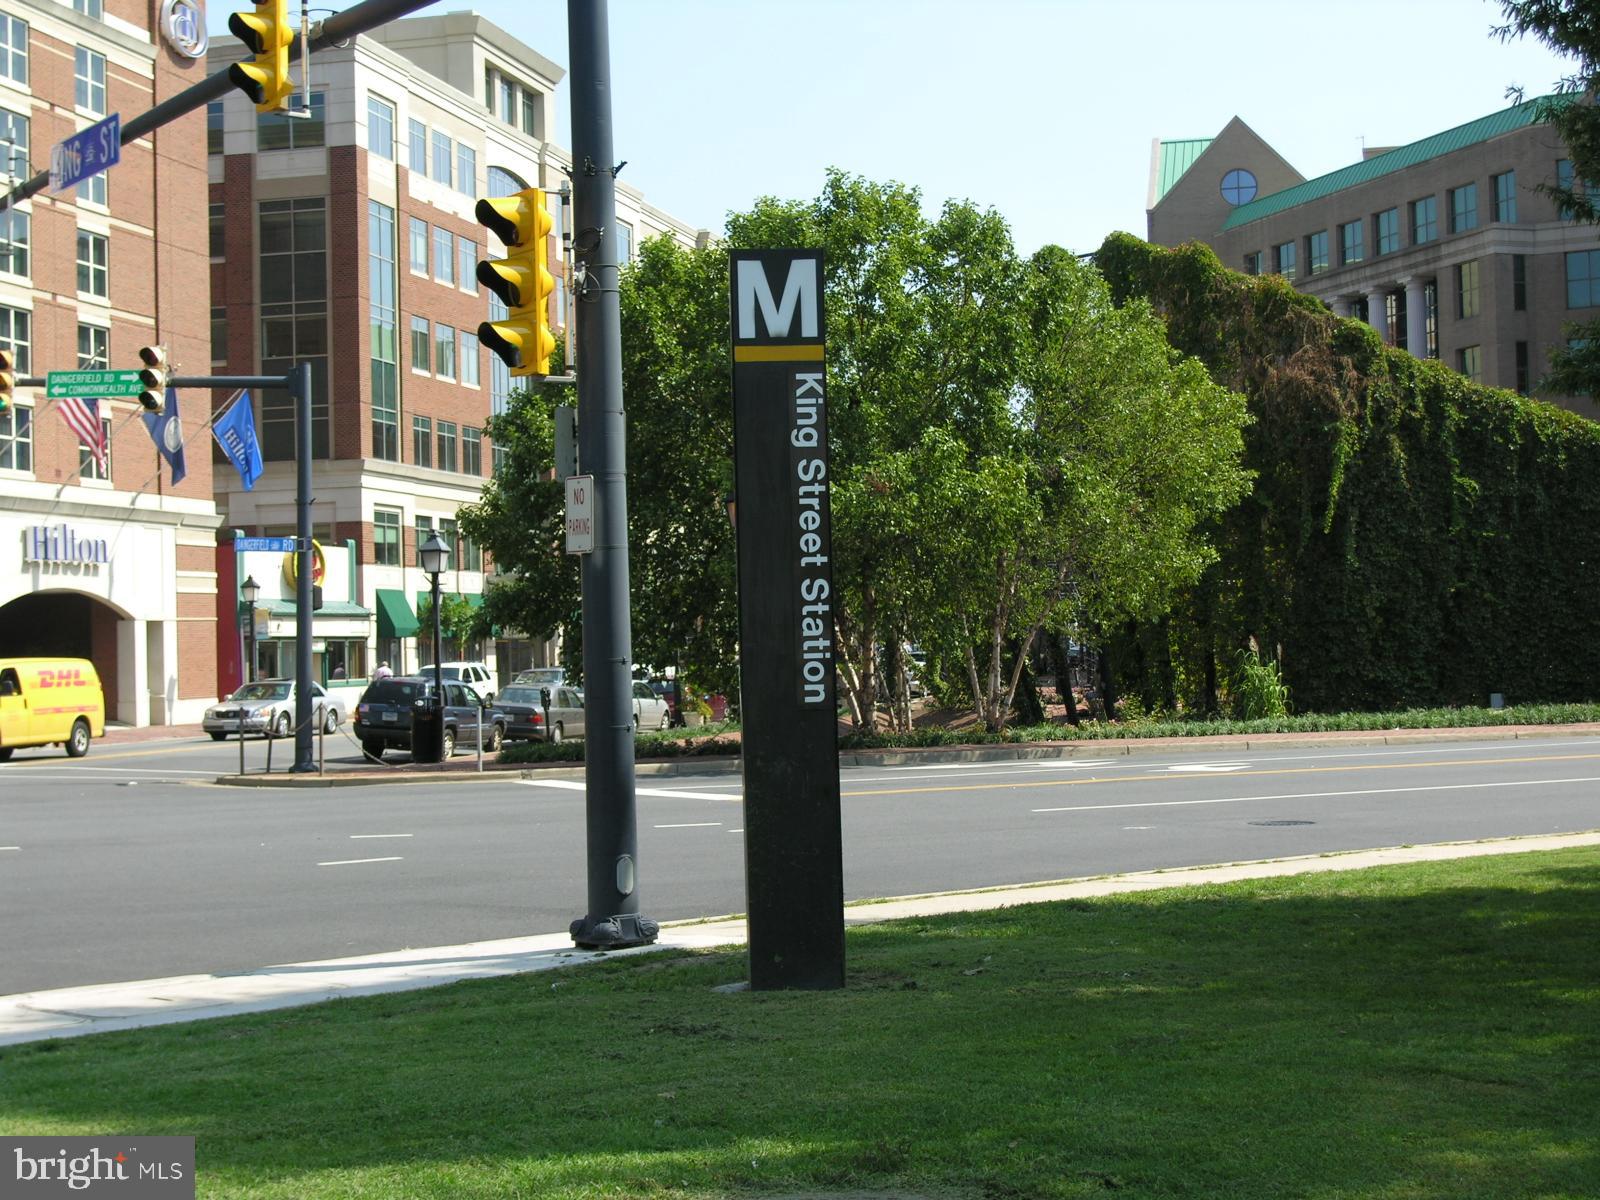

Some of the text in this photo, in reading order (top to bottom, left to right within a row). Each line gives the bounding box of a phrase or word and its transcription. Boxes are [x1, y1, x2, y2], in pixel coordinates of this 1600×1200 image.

[100, 121, 116, 164] ST
[737, 259, 818, 339] M
[104, 373, 114, 383] RD
[68, 383, 144, 395] COMMONWEALTH AVE
[573, 487, 585, 504] NO
[569, 518, 590, 536] PARKING
[29, 523, 107, 563] Hilton
[282, 539, 294, 551] RD
[790, 372, 831, 703] King Street Station
[38, 670, 86, 688] DHL
